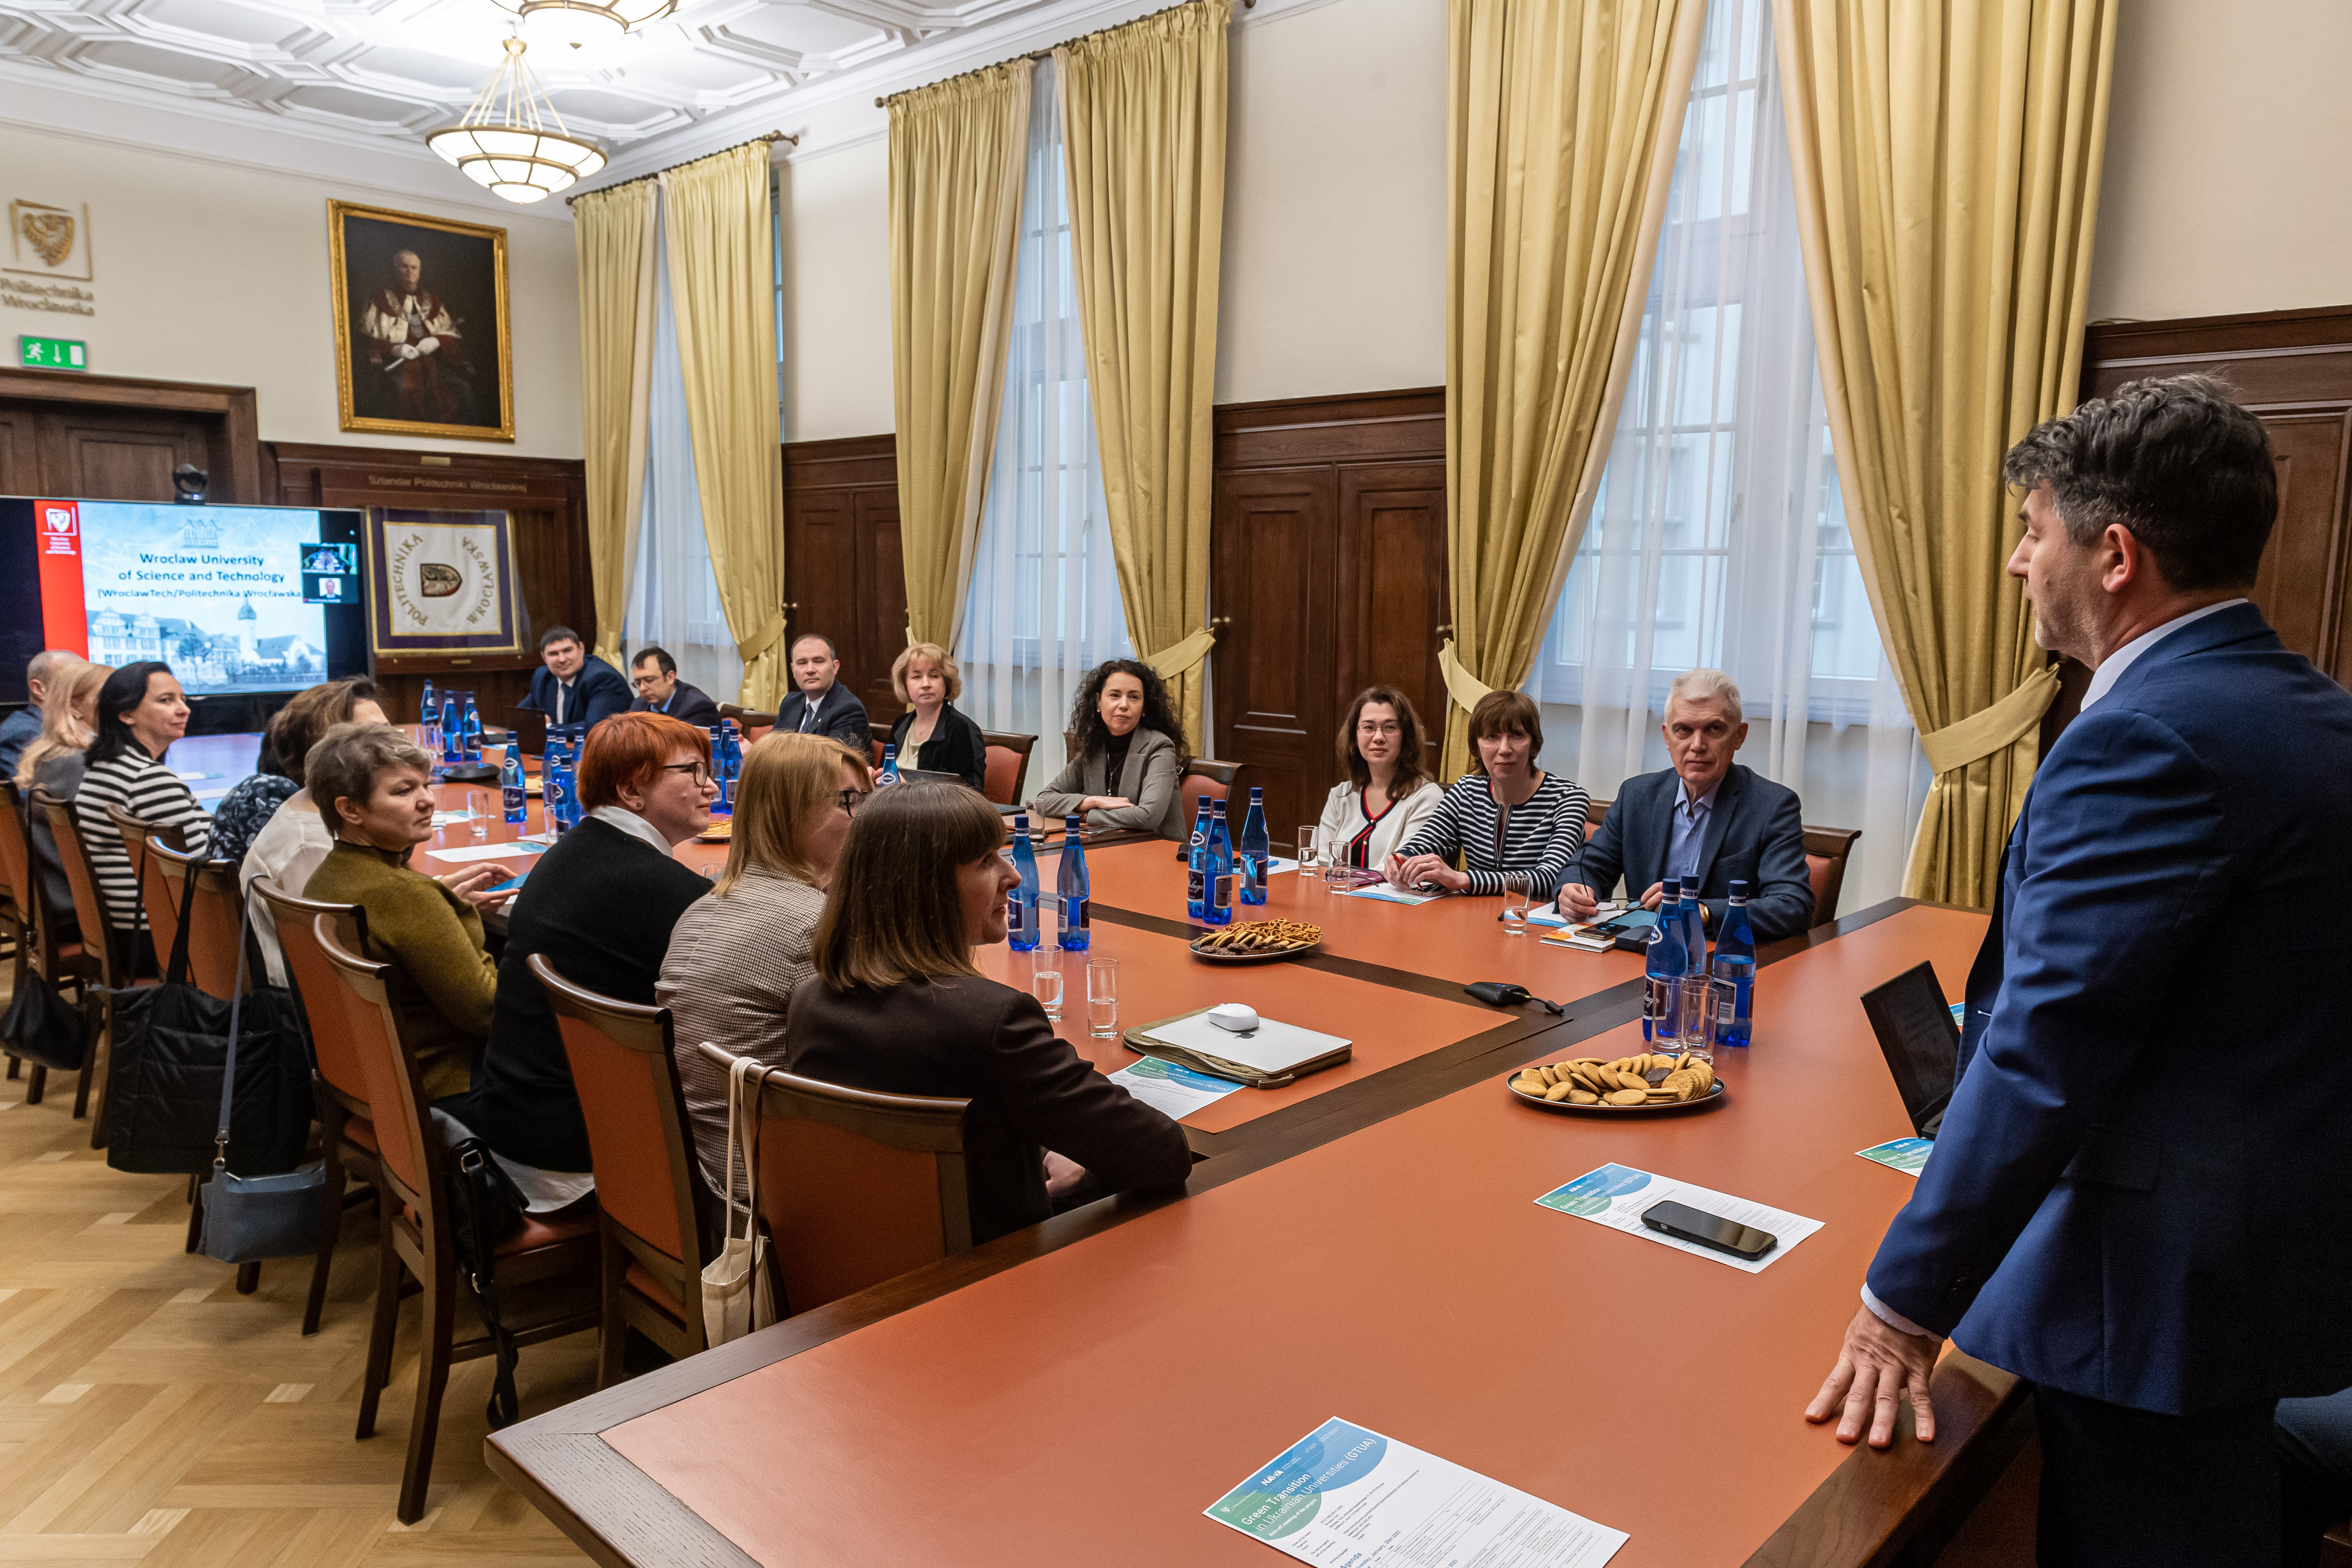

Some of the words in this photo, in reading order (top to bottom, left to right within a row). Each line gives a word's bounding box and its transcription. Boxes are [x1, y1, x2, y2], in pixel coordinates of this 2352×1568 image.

[201, 554, 264, 566] University
[118, 570, 131, 580] of
[136, 570, 185, 580] Science
[189, 571, 212, 580] and
[216, 571, 284, 583] Technology
[393, 534, 428, 626] POLITECHNIKA
[1159, 1069, 1188, 1079] Transition
[1205, 1083, 1229, 1092] (GTUA)
[1623, 1173, 1644, 1185] (GTUA)
[1560, 1199, 1578, 1210] Green
[1577, 1187, 1603, 1202] Transition
[1255, 1523, 1267, 1531] in
[1263, 1493, 1305, 1524] Ukrainian
[1302, 1459, 1349, 1494] Universities
[1344, 1438, 1377, 1461] (GTUA)
[1260, 1469, 1285, 1486] NAWA
[1241, 1505, 1271, 1525] Green
[1266, 1473, 1311, 1505] Transition
[1269, 1525, 1283, 1536] Kick-off
[1282, 1516, 1298, 1527] meeting
[1304, 1498, 1318, 1510] project
[1340, 1552, 1363, 1568] Agenda
